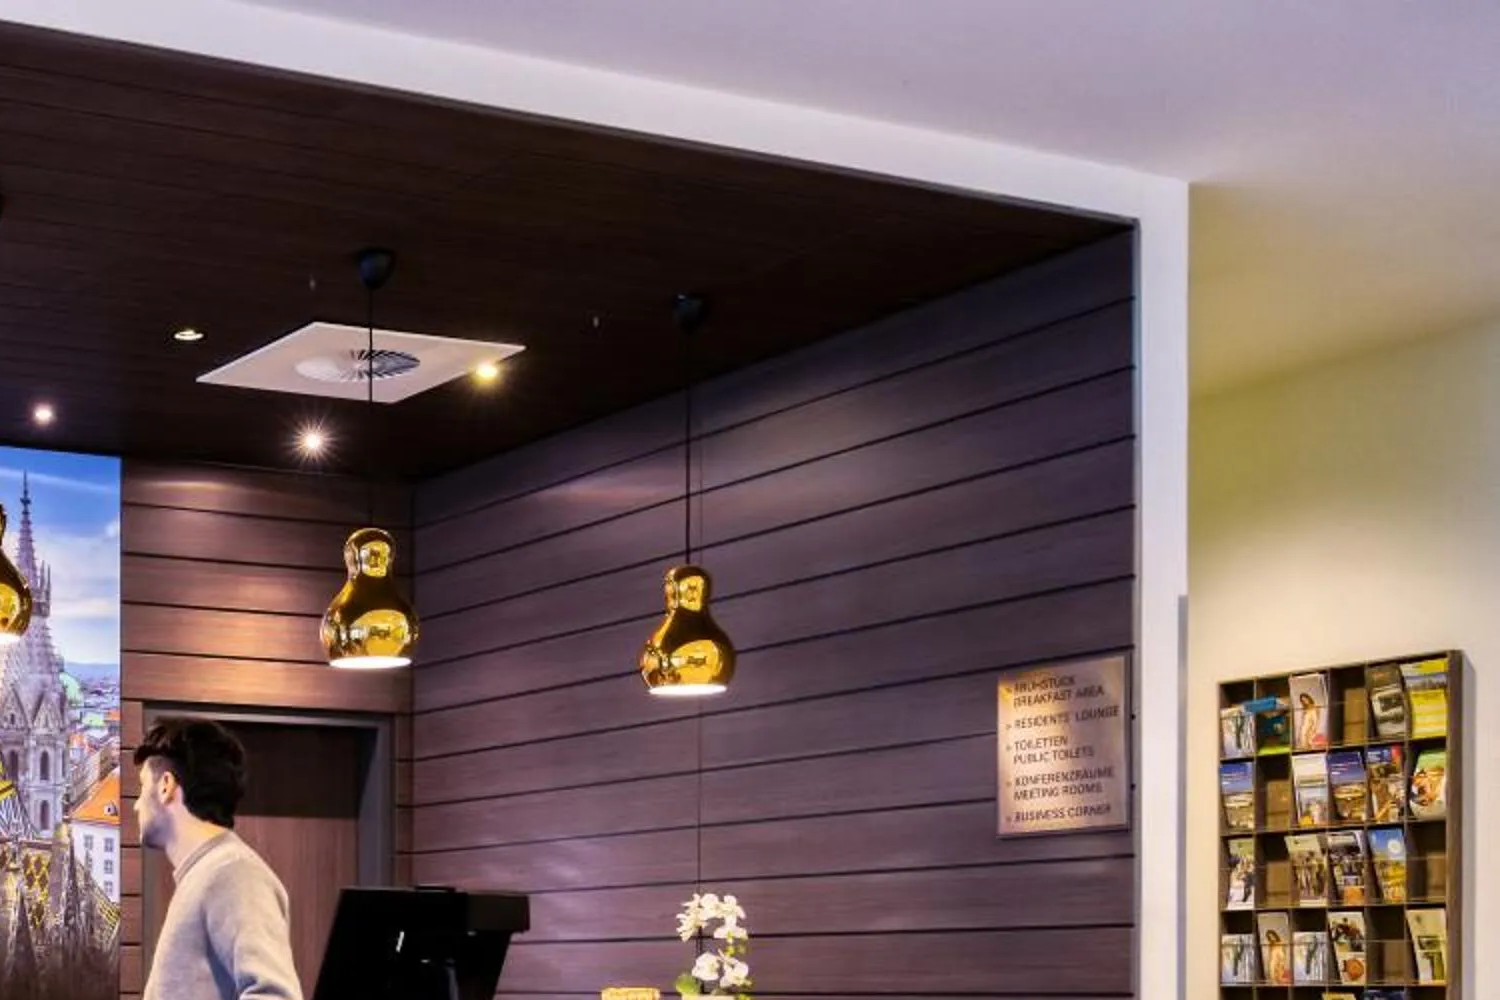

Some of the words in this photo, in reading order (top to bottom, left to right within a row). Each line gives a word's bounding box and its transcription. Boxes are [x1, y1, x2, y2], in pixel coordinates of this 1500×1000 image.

[1014, 689, 1071, 707] BREAKFAST
[1076, 685, 1104, 698] AREA
[1076, 705, 1119, 721] LOUNGE
[1014, 735, 1068, 752] TOILETTEN
[1013, 750, 1050, 765] PUBLIC
[1052, 745, 1093, 760] TOILETS
[1014, 786, 1059, 800] MEETING
[1062, 783, 1102, 795] ROOMS
[1014, 807, 1065, 822] BUSINESS
[1067, 804, 1110, 817] CORNER
